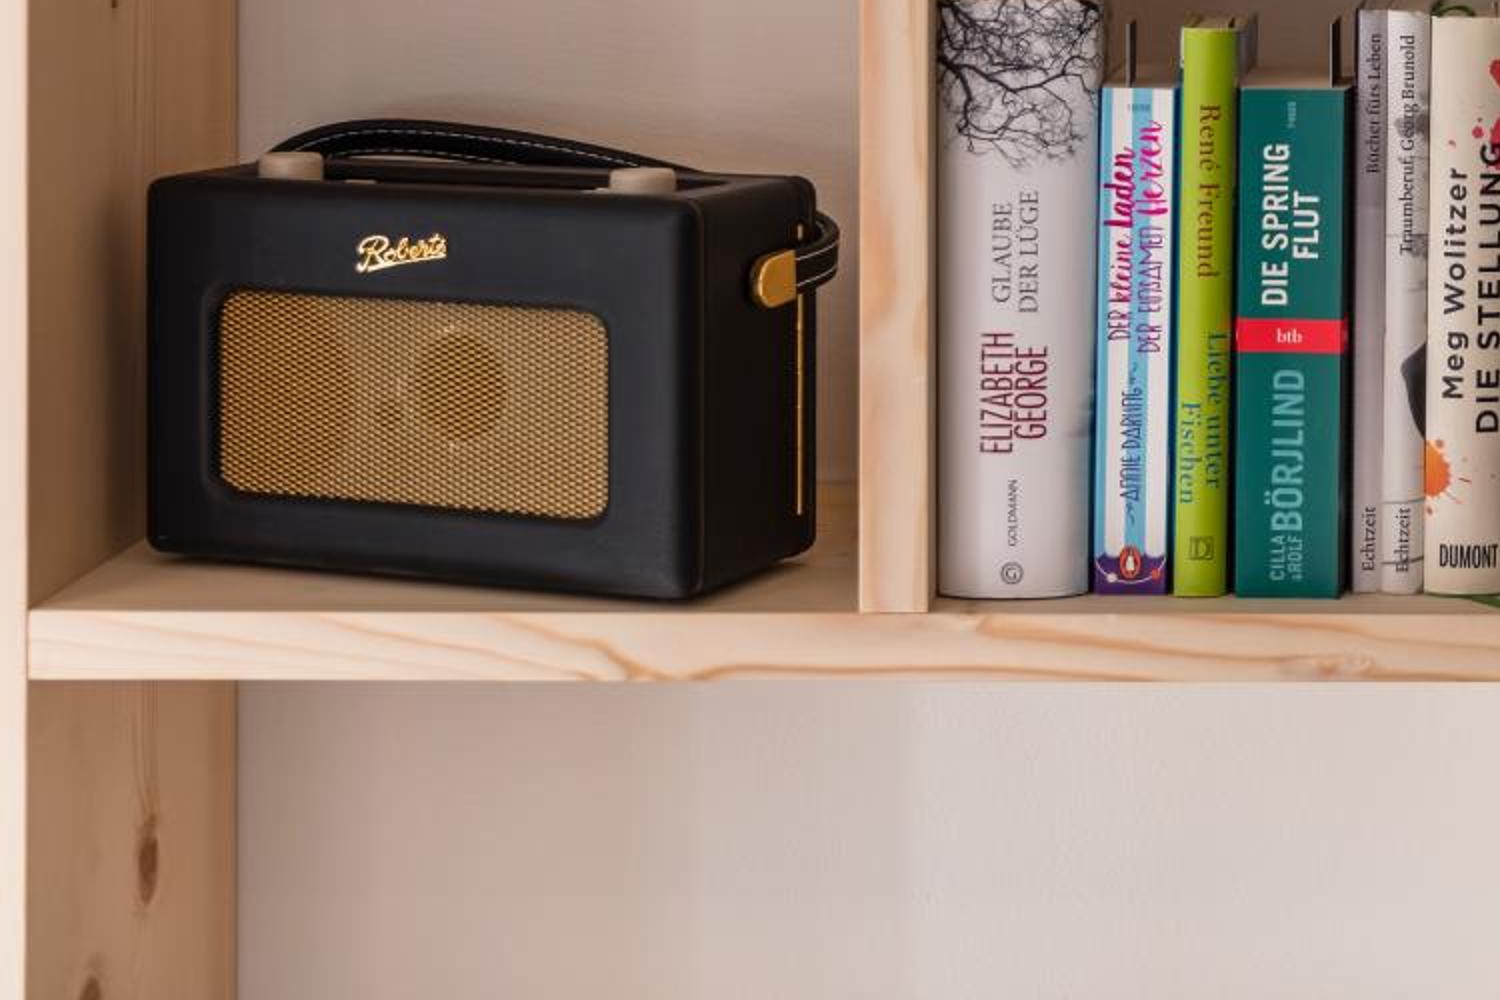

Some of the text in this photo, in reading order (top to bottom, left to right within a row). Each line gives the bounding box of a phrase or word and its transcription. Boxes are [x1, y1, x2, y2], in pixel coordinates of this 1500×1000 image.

[1365, 33, 1384, 174] Bücher fürs Leben
[1401, 35, 1418, 100] Brunold
[1137, 120, 1168, 218] Herzen
[1402, 102, 1419, 150] Georg
[1197, 104, 1221, 278] René Freund
[1262, 144, 1290, 305] DIE SPRING
[1292, 191, 1321, 259] FLUT
[355, 233, 447, 272] Roberts
[991, 202, 1013, 303] GLAUBE
[1013, 191, 1040, 313] DER LÜGE
[1104, 146, 1138, 341] DER kleine Laden
[1442, 168, 1469, 399] Meg Wolitzer
[1136, 325, 1162, 354] DER
[1276, 328, 1303, 343] btb
[980, 332, 1014, 454] ELIZABETH
[1014, 346, 1048, 441] GEORGE
[1207, 331, 1229, 488] Liebe unter
[1476, 369, 1500, 433] DIE
[1180, 402, 1201, 504] Fischen
[1264, 368, 1305, 531] BÖRJLIND
[1007, 479, 1018, 547] GOLDMANN
[1271, 534, 1285, 581] CILLA
[1362, 505, 1377, 572] Echtzeit
[1396, 507, 1411, 573] Echtzeit
[1439, 543, 1499, 569] DUMONT
